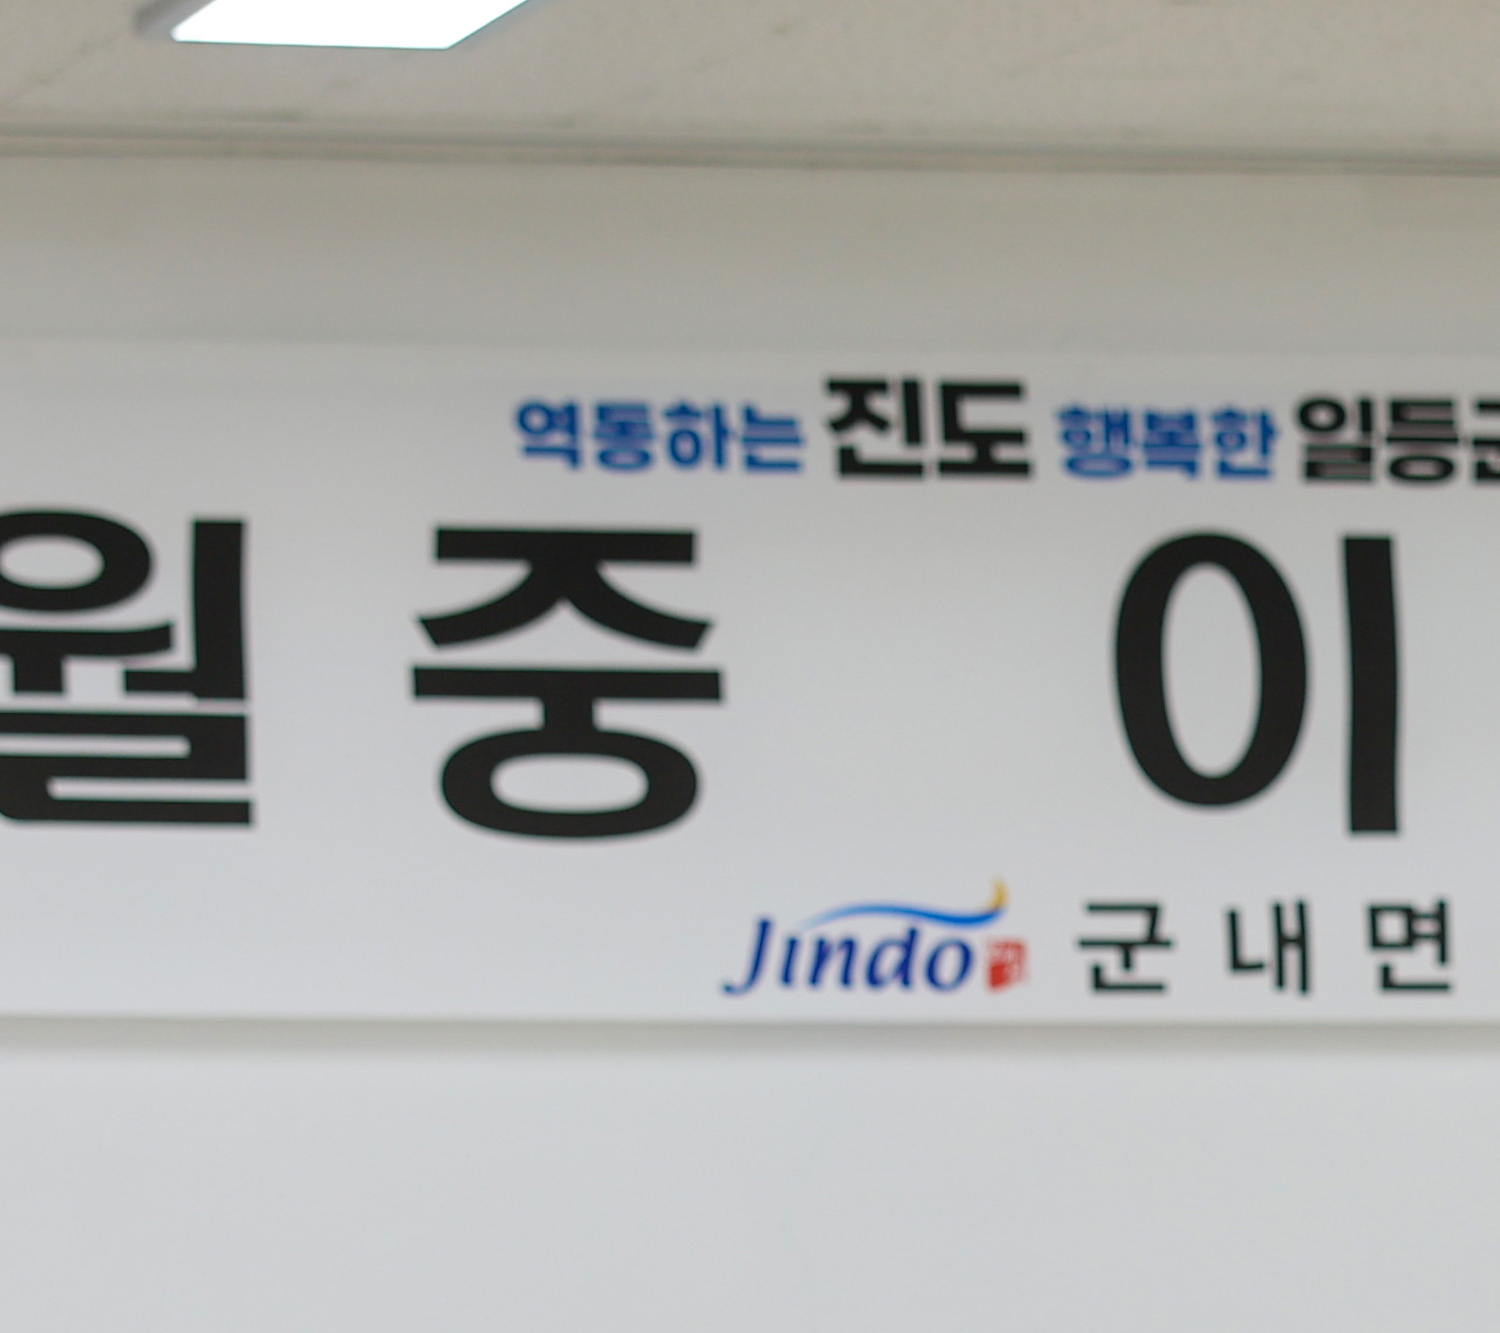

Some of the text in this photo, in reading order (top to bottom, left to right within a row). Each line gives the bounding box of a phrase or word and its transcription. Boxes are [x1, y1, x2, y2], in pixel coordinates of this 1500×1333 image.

[514, 399, 805, 473] 역동하는
[824, 377, 1033, 480] 진도
[1056, 404, 1280, 480] 행복한
[723, 917, 976, 995] Jindo
[1078, 899, 1451, 995] 군내면
